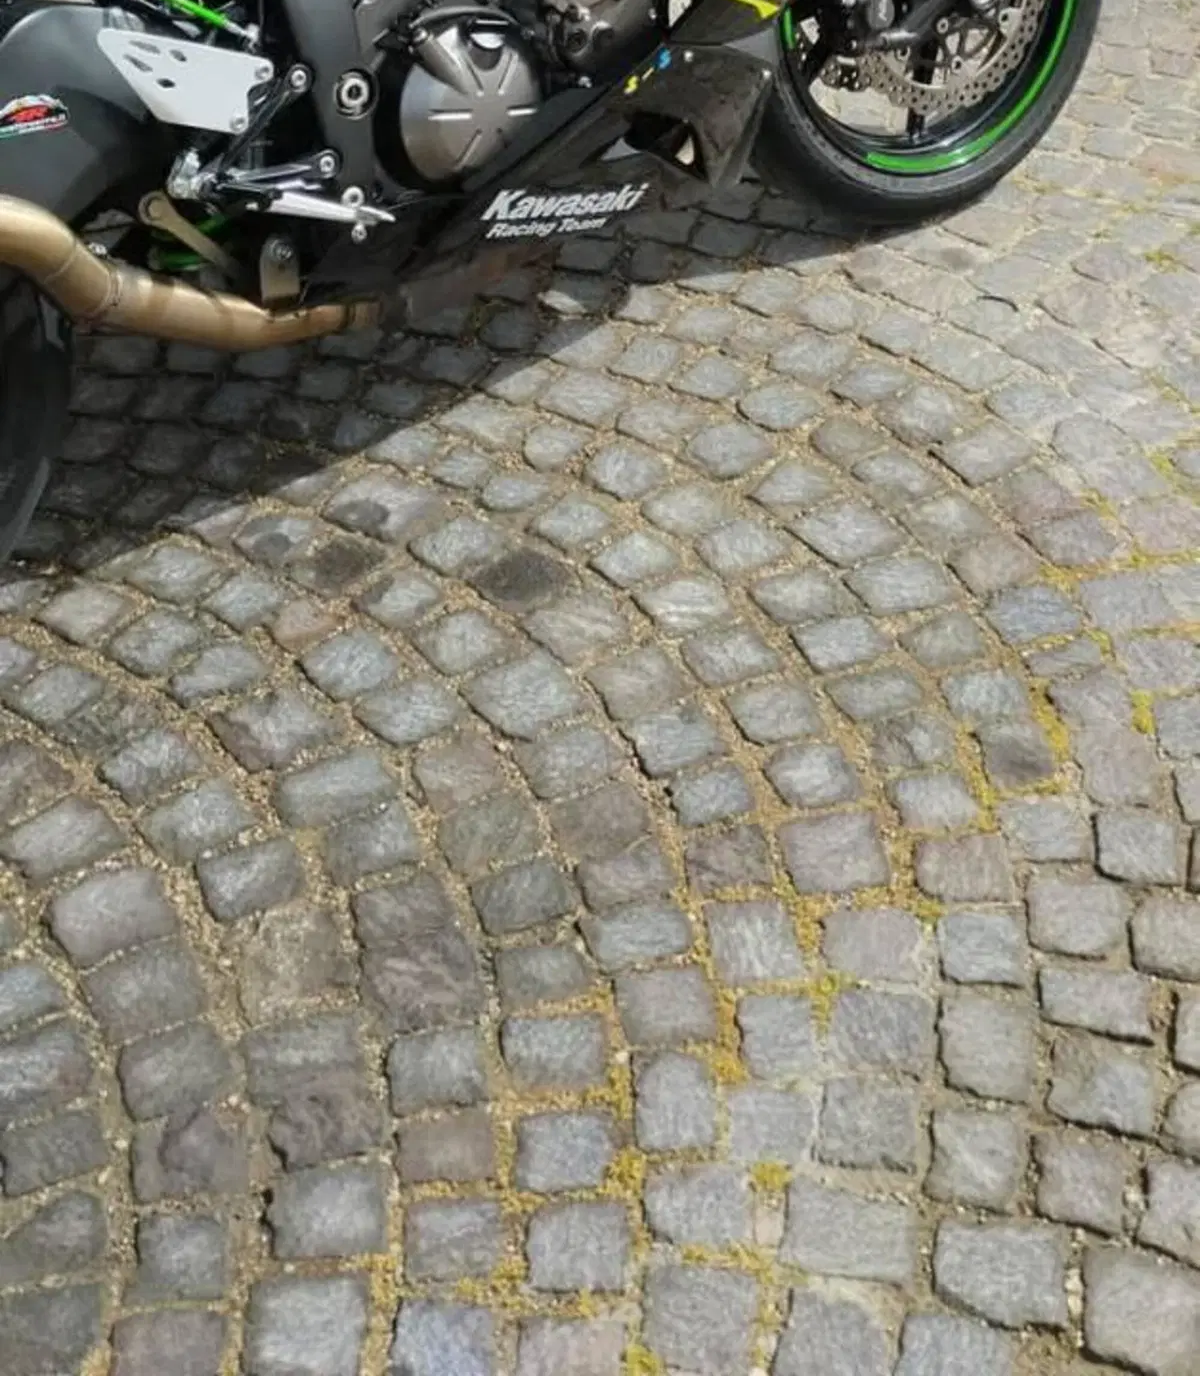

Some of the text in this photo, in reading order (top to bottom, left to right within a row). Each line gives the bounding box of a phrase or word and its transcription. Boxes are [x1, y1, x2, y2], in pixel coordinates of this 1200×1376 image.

[480, 183, 650, 221] Kawasaki
[485, 217, 607, 239] Racing Team
